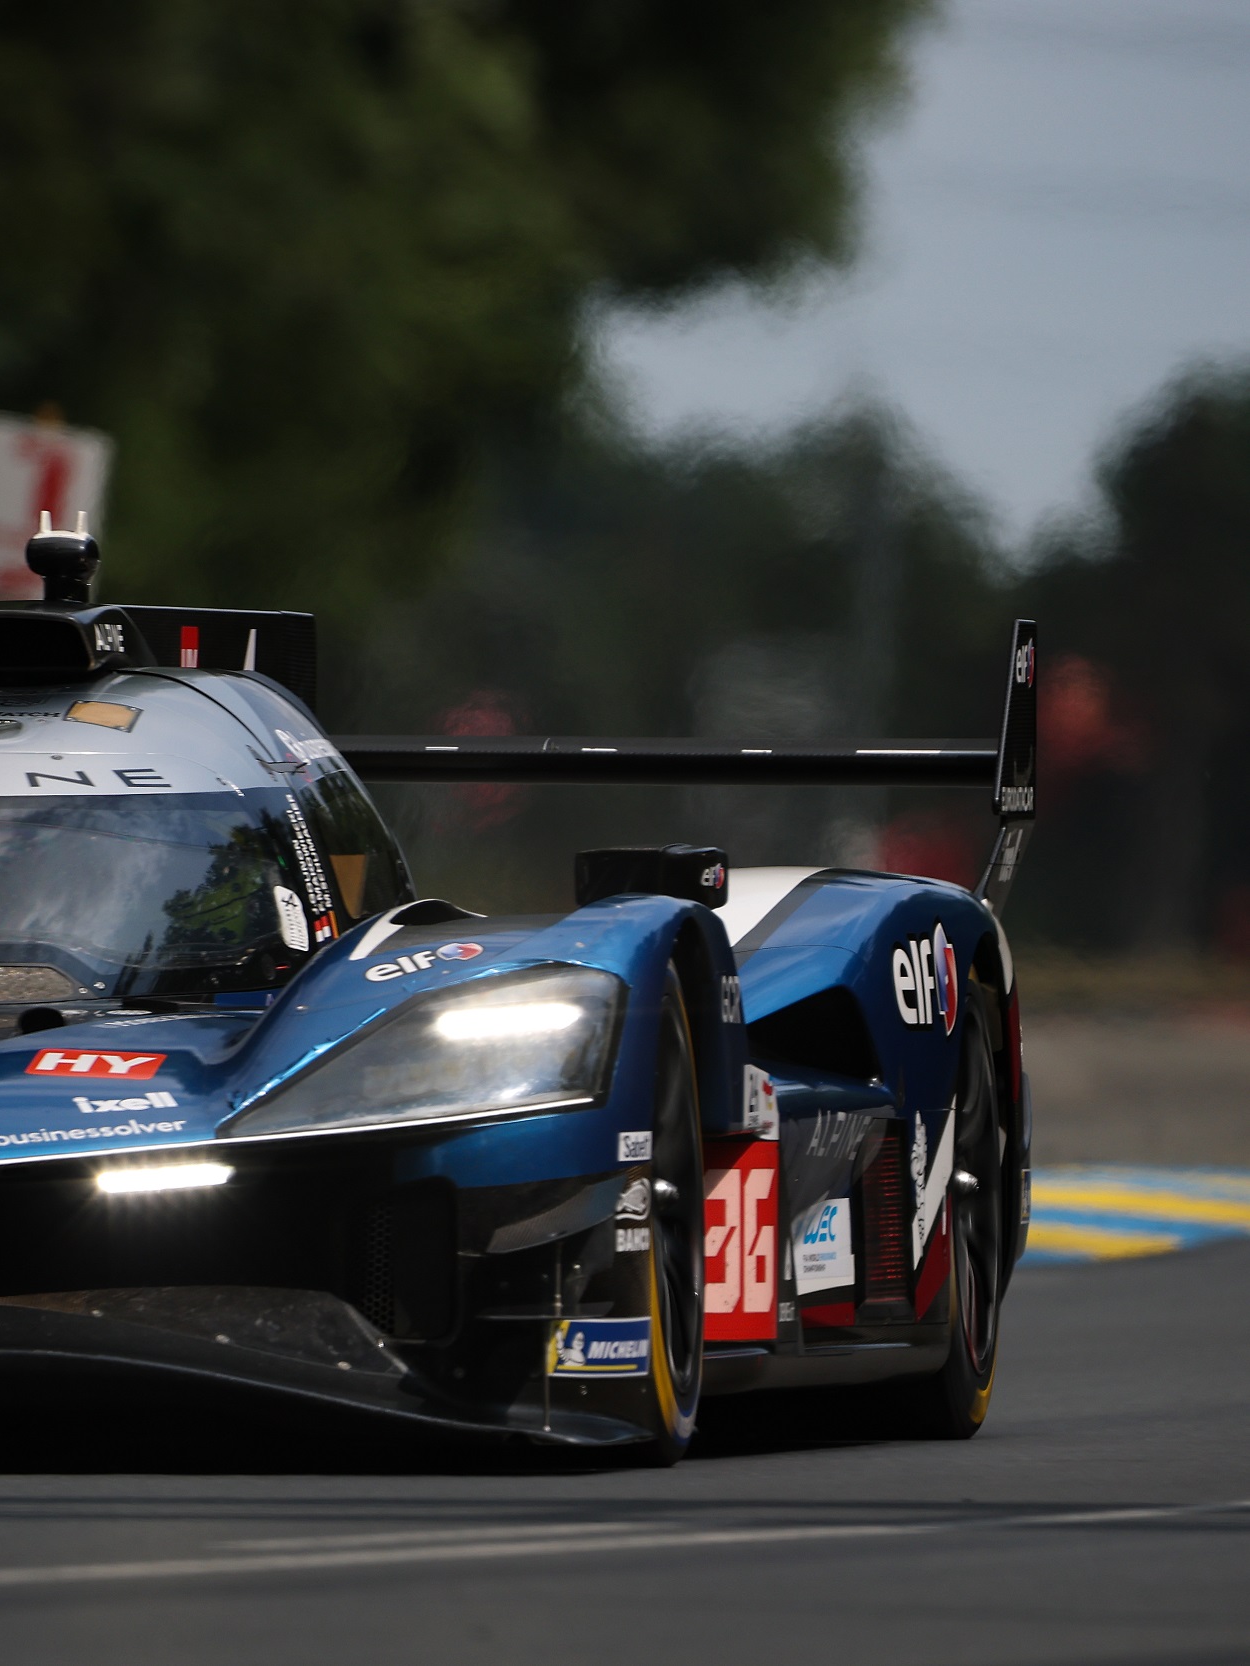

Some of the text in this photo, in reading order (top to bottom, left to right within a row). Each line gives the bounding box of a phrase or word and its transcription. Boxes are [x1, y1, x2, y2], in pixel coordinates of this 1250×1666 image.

[365, 951, 436, 982] elf
[893, 939, 935, 1025] elf
[35, 1052, 158, 1074] HY
[72, 1091, 178, 1113] ixell
[806, 1108, 871, 1160] ALPINE
[703, 1168, 775, 1313] 36
[803, 1205, 838, 1244] WEC
[587, 1339, 649, 1359] MICHELIN
